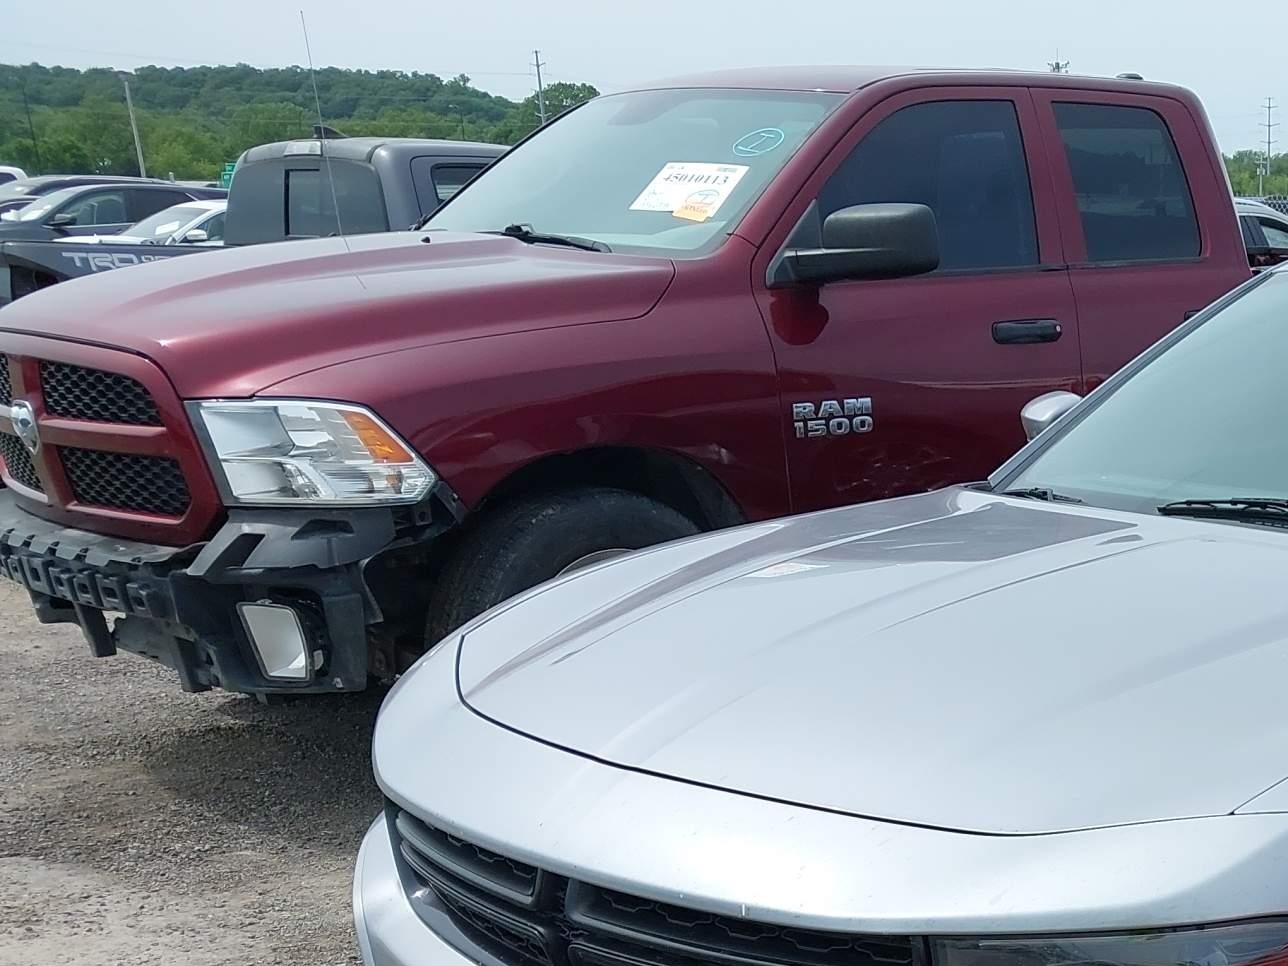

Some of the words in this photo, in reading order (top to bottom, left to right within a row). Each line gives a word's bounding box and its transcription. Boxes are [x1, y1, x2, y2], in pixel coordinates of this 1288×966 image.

[664, 173, 729, 186] 45010113
[62, 252, 138, 271] TRD
[793, 397, 872, 419] RAM
[794, 416, 873, 438] 1500
